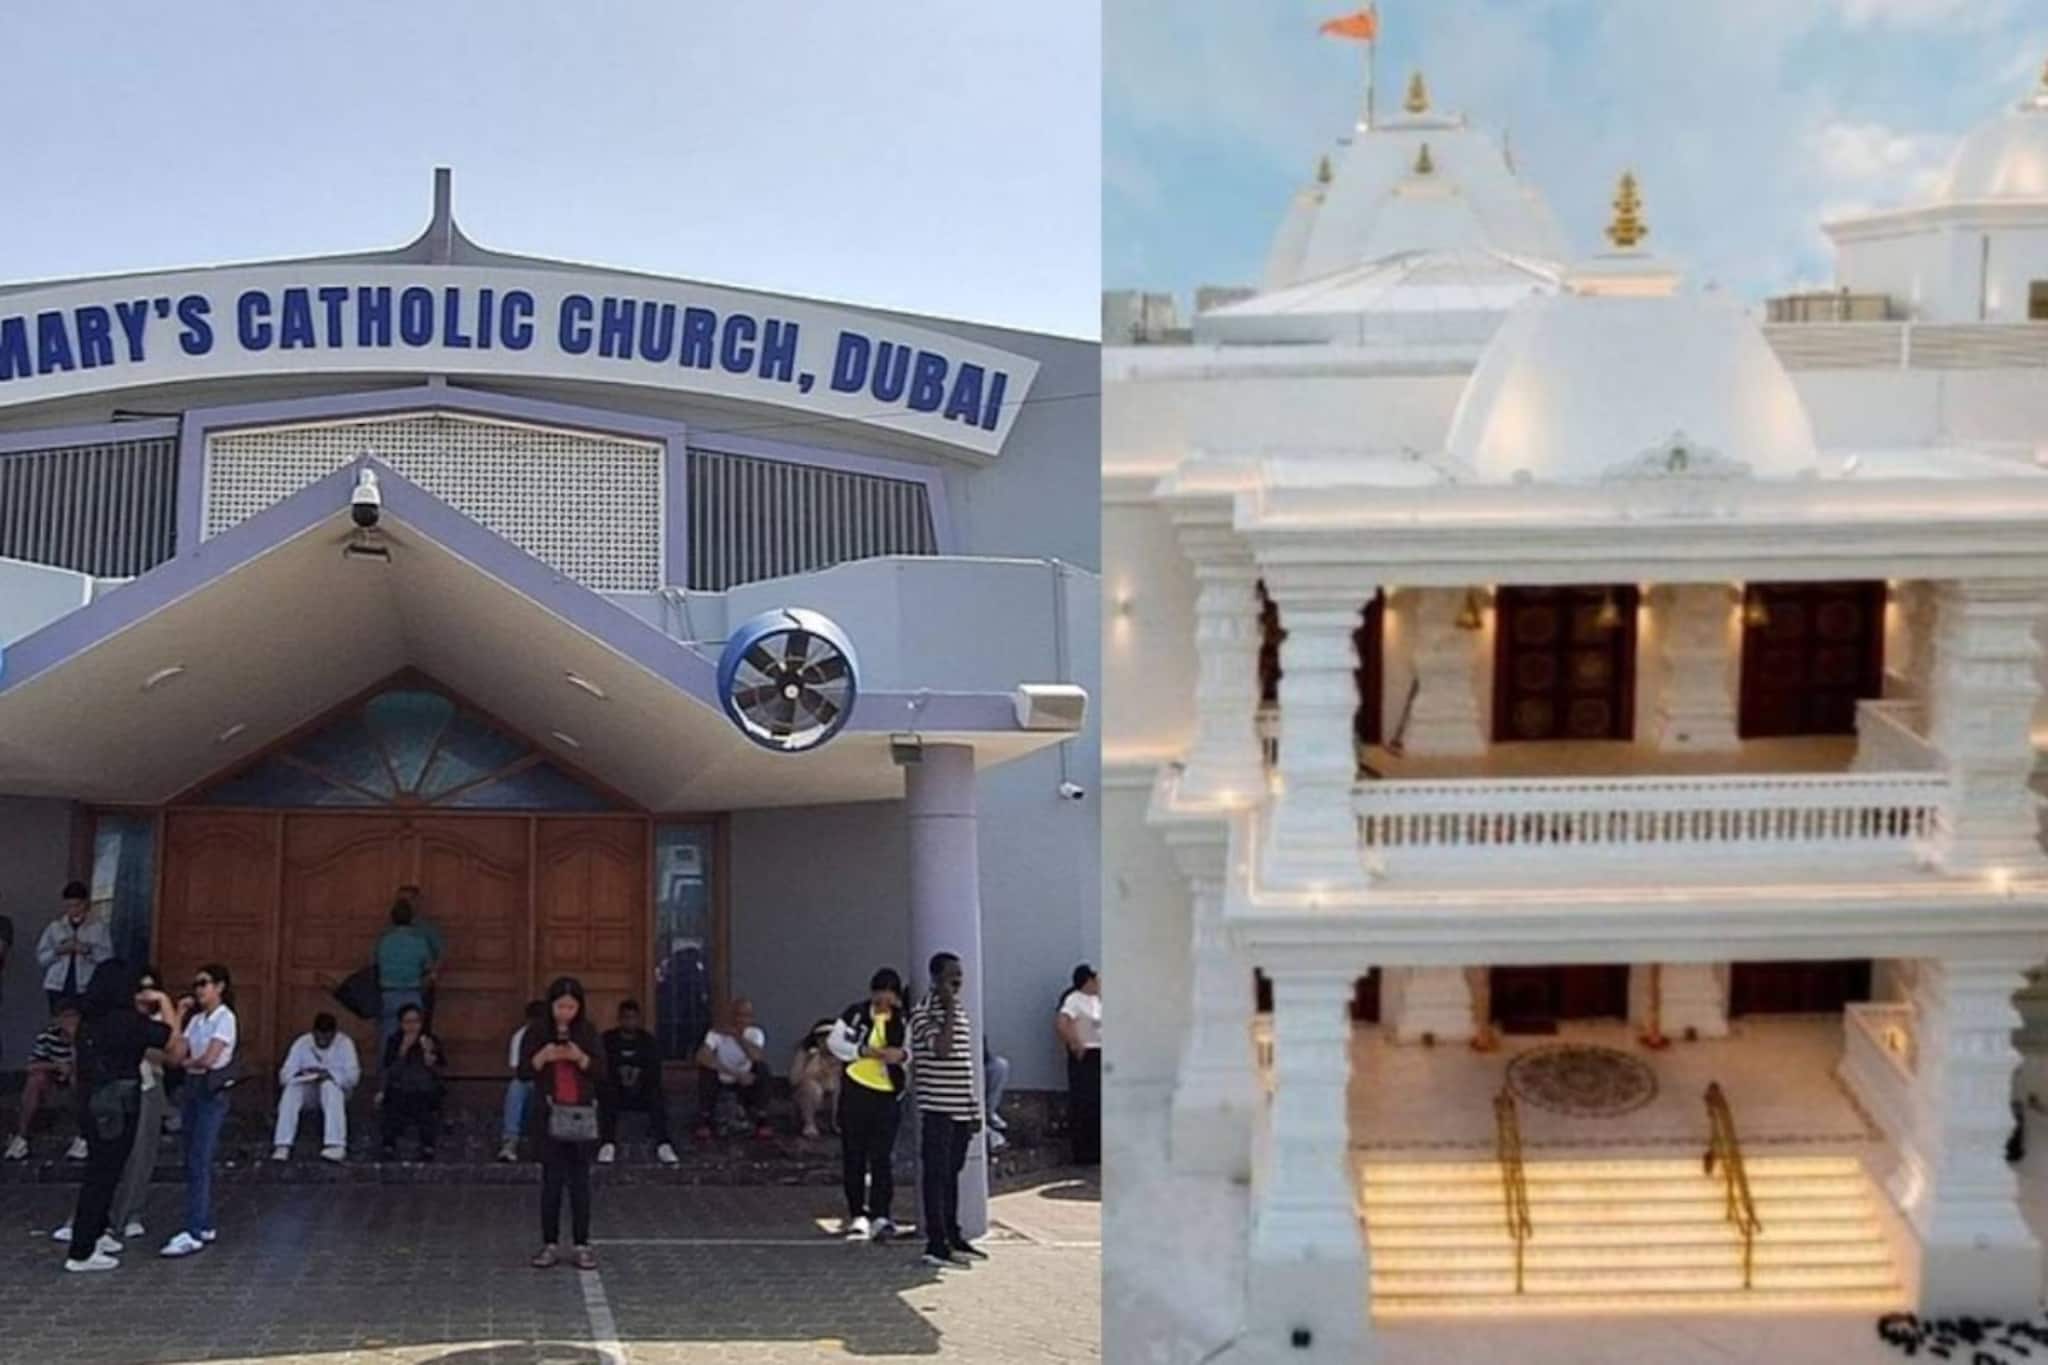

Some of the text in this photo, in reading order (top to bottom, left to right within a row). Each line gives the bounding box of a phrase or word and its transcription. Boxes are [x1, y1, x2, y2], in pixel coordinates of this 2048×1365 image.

[237, 286, 535, 351] CATHOLIC
[558, 294, 814, 394] CHURCH,
[830, 331, 1008, 432] DUBAI
